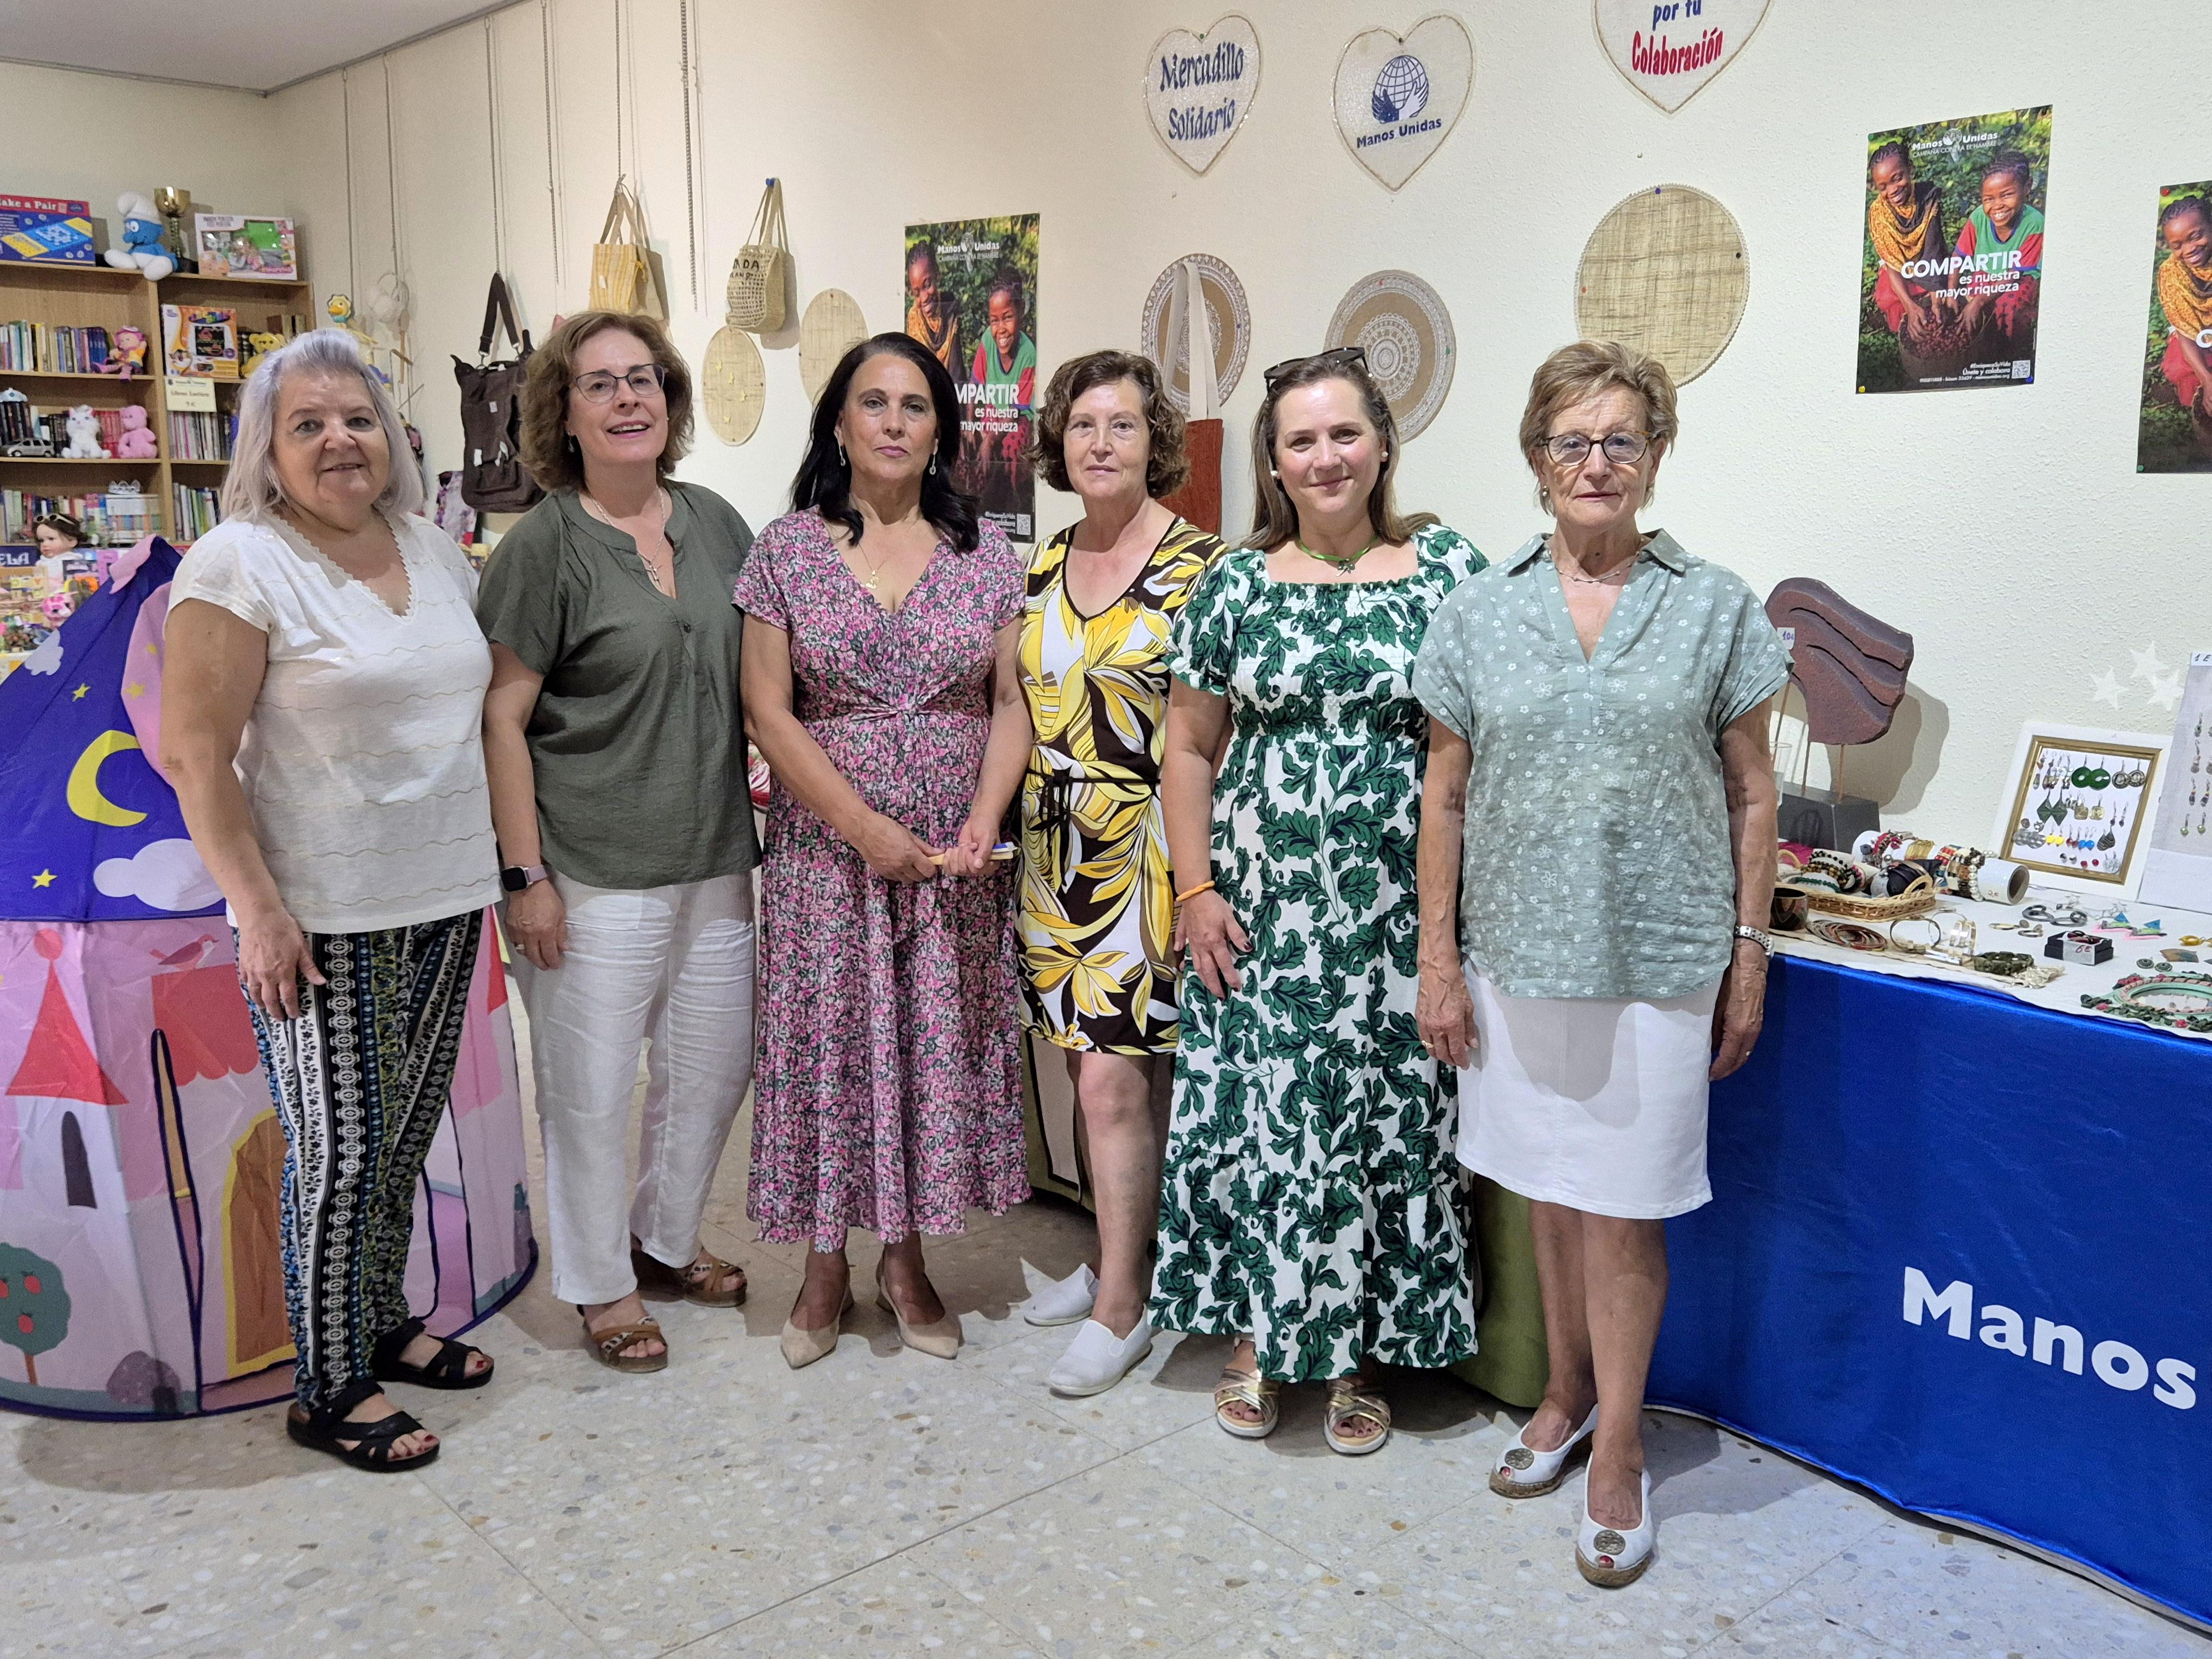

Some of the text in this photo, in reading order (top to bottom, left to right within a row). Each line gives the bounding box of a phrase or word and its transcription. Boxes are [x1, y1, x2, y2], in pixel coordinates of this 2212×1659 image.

[1652, 0, 1702, 32] por tu
[1632, 27, 1723, 75] Colaboración
[1160, 41, 1244, 92] Mercadillo
[1168, 97, 1235, 140] Solidario
[1357, 118, 1442, 148] Manos Unidas
[1912, 132, 1998, 150] Manos Unidas
[0, 199, 21, 208] ake
[34, 200, 57, 211] Pair
[937, 241, 1000, 254] Manos Unidas
[1901, 251, 2022, 279] COMPARTIR
[1959, 270, 2020, 285] es nuestra
[1936, 283, 2019, 300] mayor riqueza
[954, 383, 1019, 404] MPARTIR
[974, 406, 1018, 419] es nuestra
[960, 418, 1018, 435] mayor riqueza
[1903, 1266, 2196, 1410] Manos
